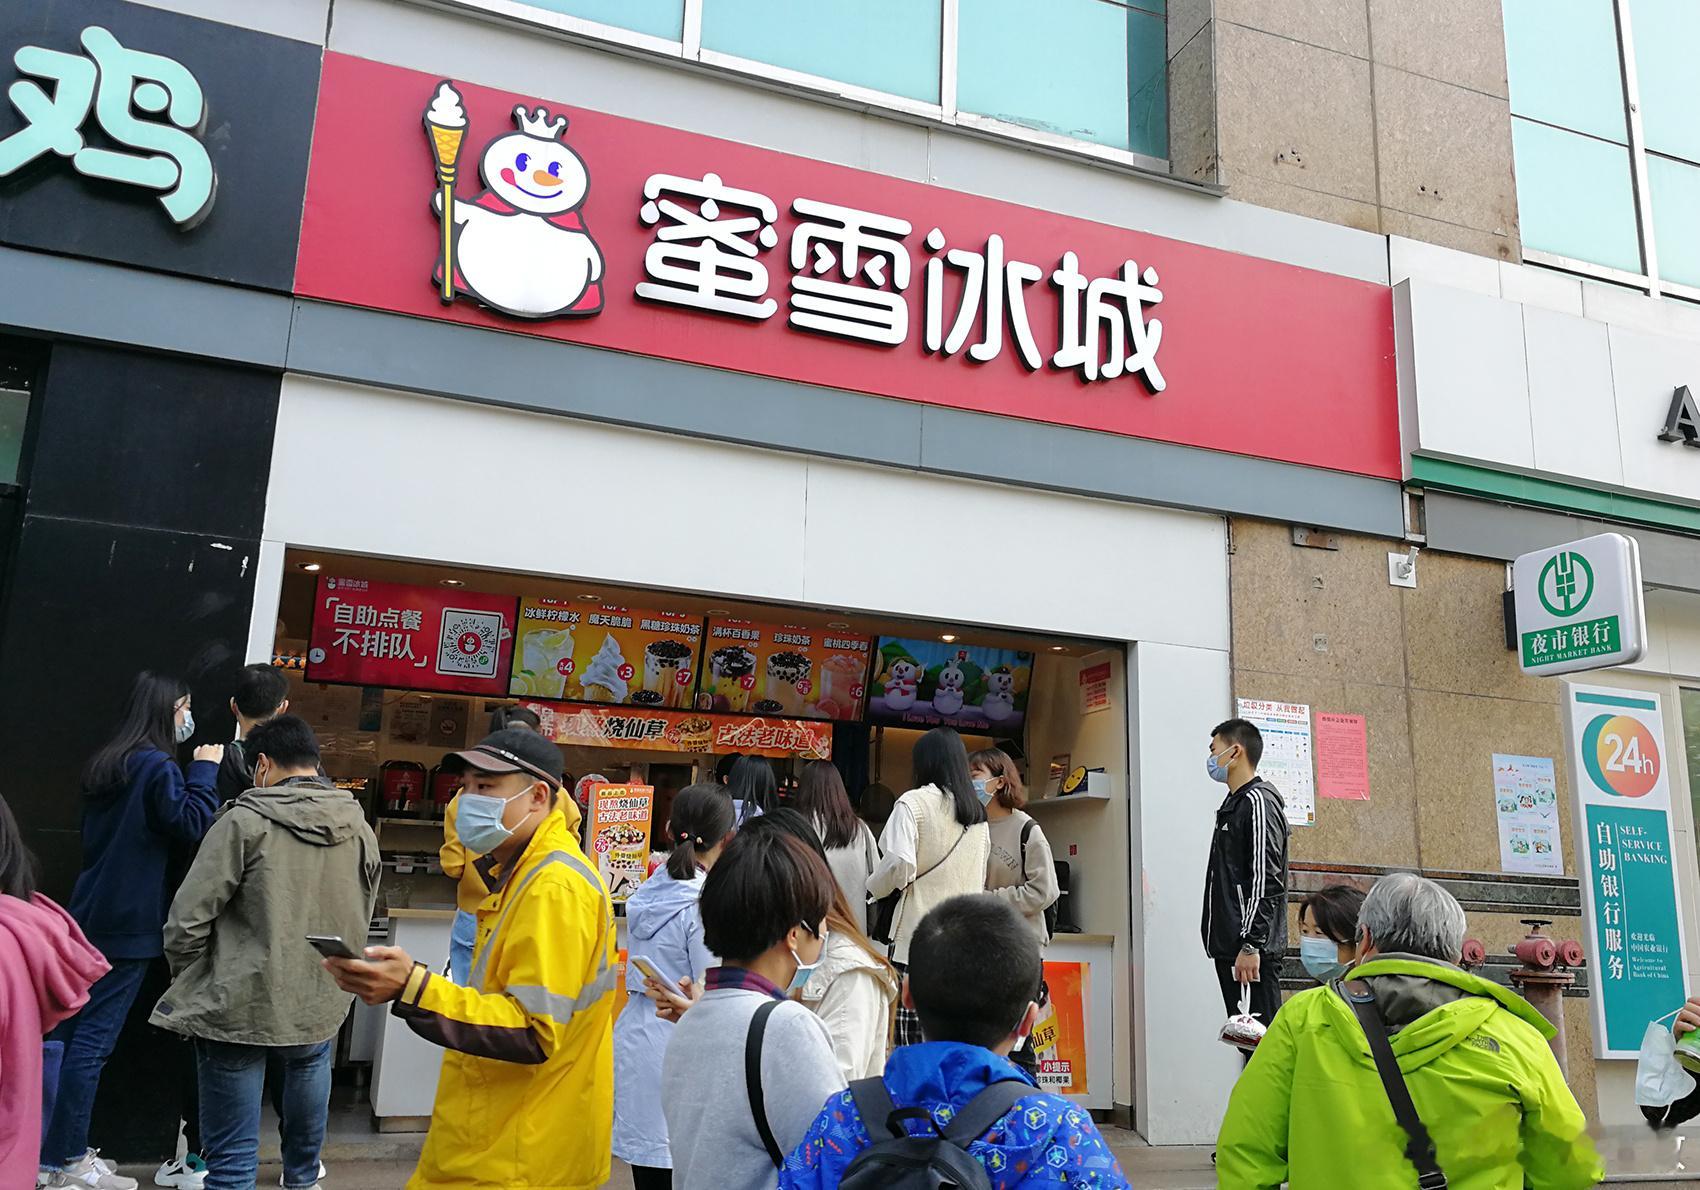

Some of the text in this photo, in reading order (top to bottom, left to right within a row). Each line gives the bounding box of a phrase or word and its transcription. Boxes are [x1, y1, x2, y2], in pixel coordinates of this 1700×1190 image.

[0, 25, 215, 224] 鸡
[634, 172, 1168, 393] 蜜雪冰城
[524, 607, 581, 623] 冰鲜柠檬水
[640, 619, 701, 635] 黑糖珍珠奶茶
[712, 626, 761, 642] 满杯百香果
[773, 632, 812, 646] 珍珠奶茶
[823, 638, 869, 651] 蜜桃四季春
[1530, 621, 1611, 656] 夜市银行
[1531, 644, 1612, 664] NIGHT MARKET BANK
[716, 722, 814, 751] 古法老味道
[1604, 733, 1654, 775] 24h
[1620, 825, 1648, 836] SELF-
[1622, 839, 1663, 851] SERVICE
[1624, 852, 1668, 864] BANKING
[1596, 821, 1624, 981] 自助银行服务
